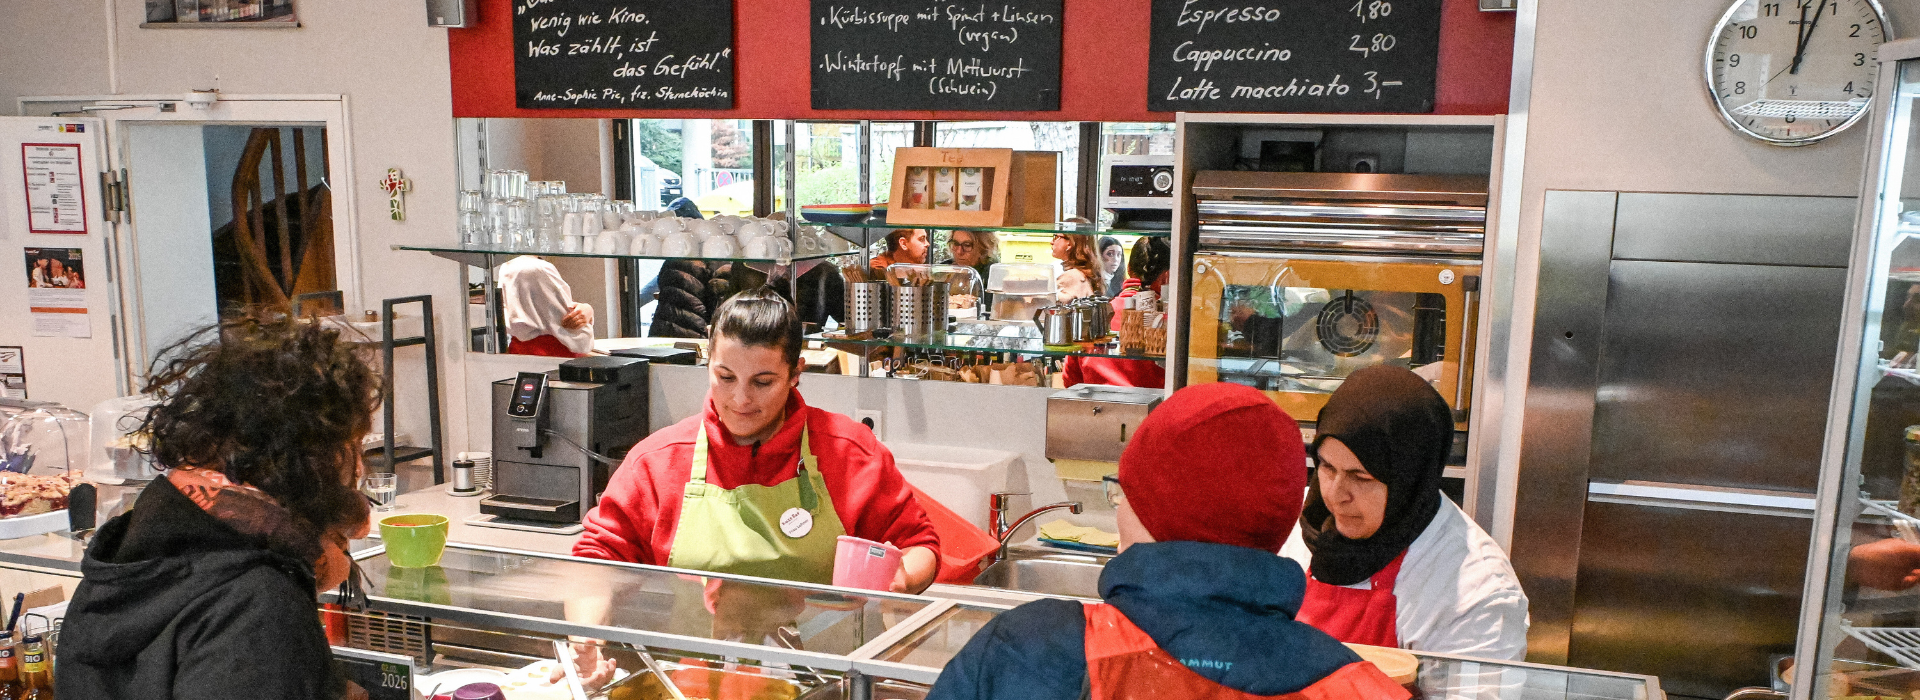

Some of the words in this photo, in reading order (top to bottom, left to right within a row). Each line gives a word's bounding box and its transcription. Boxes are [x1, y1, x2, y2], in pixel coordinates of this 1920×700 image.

[578, 12, 601, 25] wie
[608, 7, 650, 25] Kino.
[1177, 0, 1280, 34] Espresso
[1350, 0, 1392, 23] 1,80
[1764, 3, 1780, 17] 11
[1830, 3, 1837, 16] 1
[830, 6, 909, 32] Kürbissuppe
[917, 8, 940, 22] mit
[958, 26, 1018, 51] (vegan)
[1739, 25, 1757, 40] 10
[1849, 24, 1861, 38] 2
[528, 40, 560, 57] Was
[568, 36, 622, 60] zählt,
[629, 31, 659, 52] ist
[1172, 40, 1291, 72] Cappuccino
[1349, 33, 1396, 58] 2,80
[825, 51, 906, 81] Wintertopf
[912, 59, 937, 73] mit
[947, 57, 1028, 78] Mettwurst
[1729, 53, 1740, 68] 9
[1853, 53, 1865, 67] 3
[613, 62, 647, 77] das
[929, 76, 997, 100] (Schwein)
[1167, 77, 1221, 100] Latte
[1231, 74, 1350, 99] macchiato
[1735, 81, 1746, 95] 8
[1843, 81, 1854, 95] 4
[534, 88, 597, 104] Anne-Sophie
[655, 86, 728, 100] Sterneköchin
[1785, 110, 1796, 124] 6
[1180, 658, 1233, 670] AMMUT
[382, 674, 408, 690] 2026
